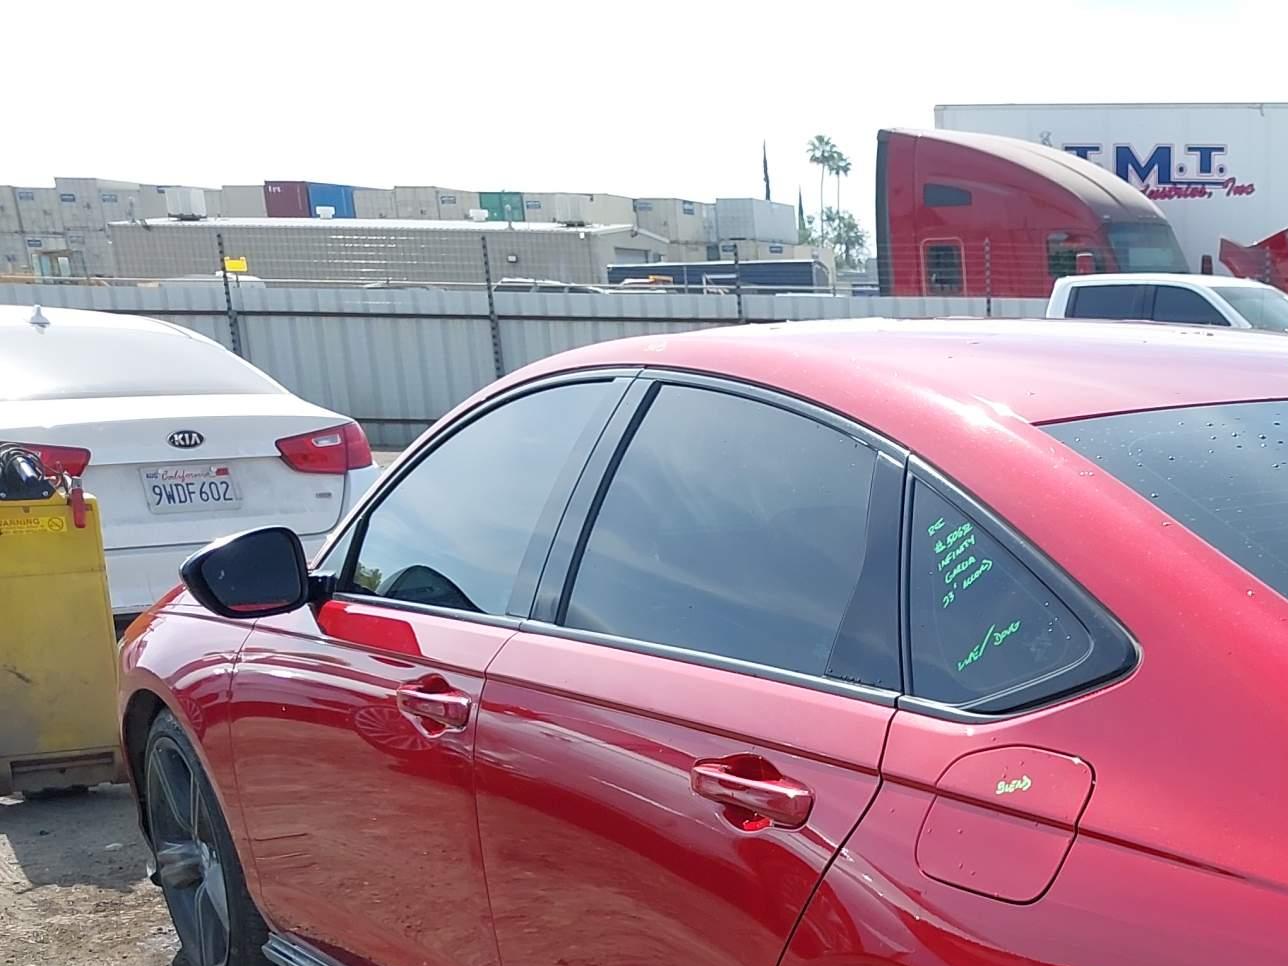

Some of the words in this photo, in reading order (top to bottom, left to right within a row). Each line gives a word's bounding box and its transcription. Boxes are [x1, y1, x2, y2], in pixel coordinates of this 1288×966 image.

[173, 433, 201, 446] KIA
[152, 480, 233, 506] 9WDF602
[0, 518, 40, 527] ARNING
